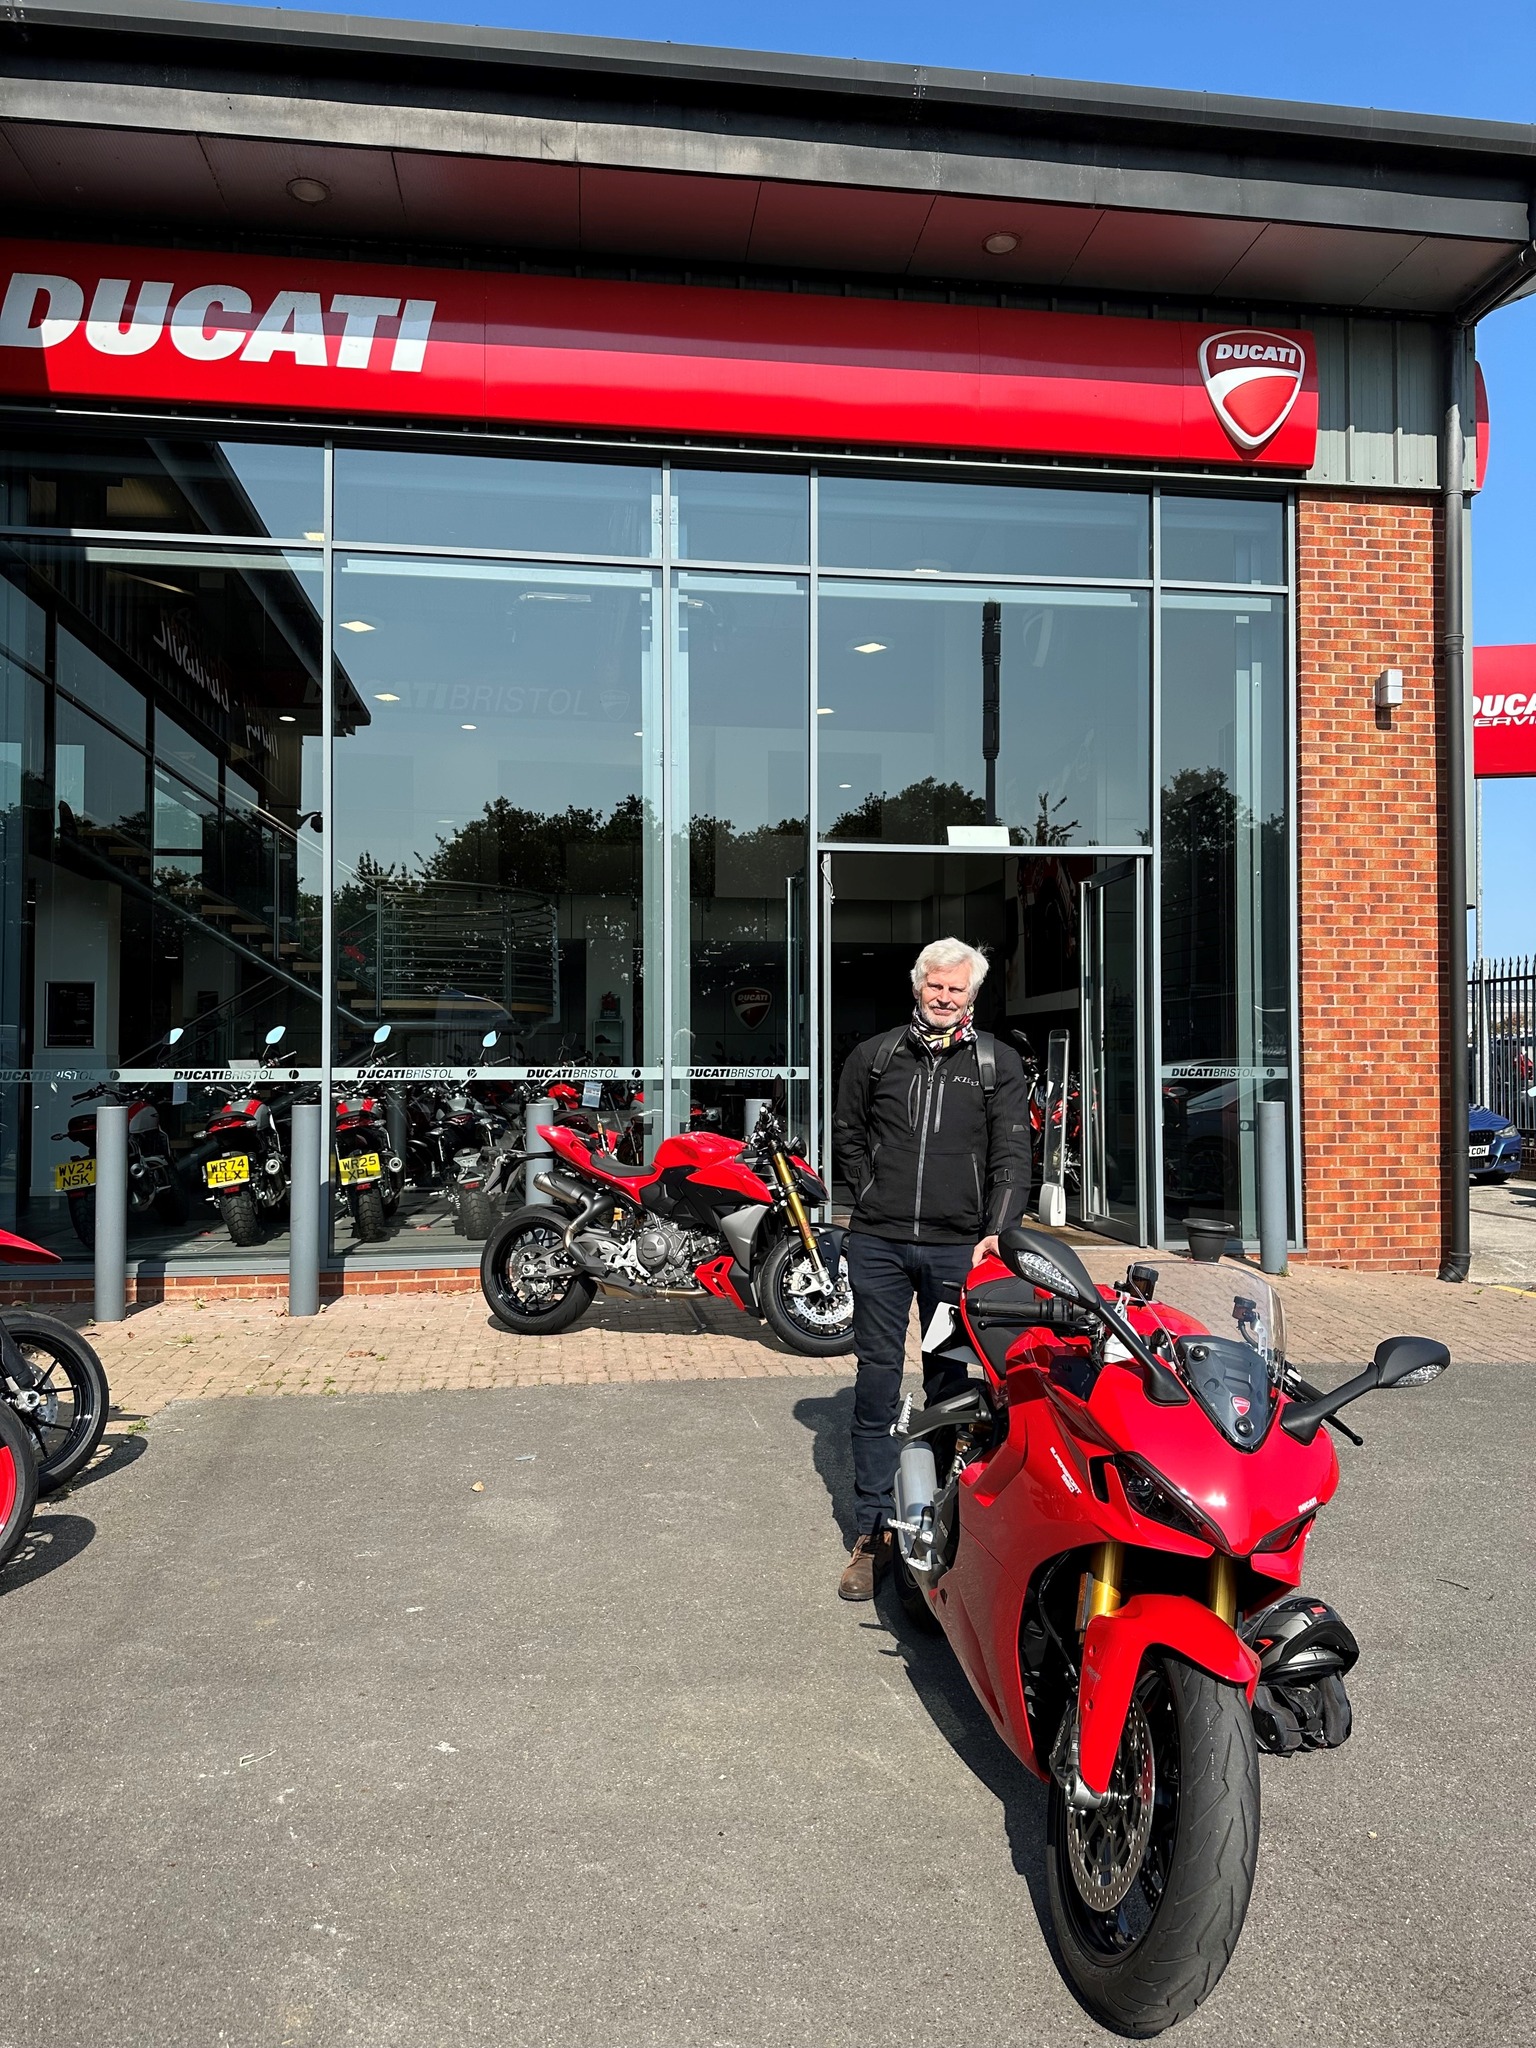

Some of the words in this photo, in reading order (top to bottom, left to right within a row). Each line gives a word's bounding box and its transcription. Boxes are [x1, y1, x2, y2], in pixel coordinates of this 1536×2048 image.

[0, 272, 437, 373] DUCATI
[1215, 344, 1297, 364] DUCATI
[1473, 716, 1536, 727] ERVI
[1471, 1147, 1487, 1155] COH
[59, 1161, 93, 1176] WV24
[210, 1158, 245, 1173] WR74
[342, 1155, 377, 1170] WR25
[62, 1173, 89, 1187] NSK
[215, 1170, 242, 1183] LLX
[348, 1168, 375, 1180] XPL
